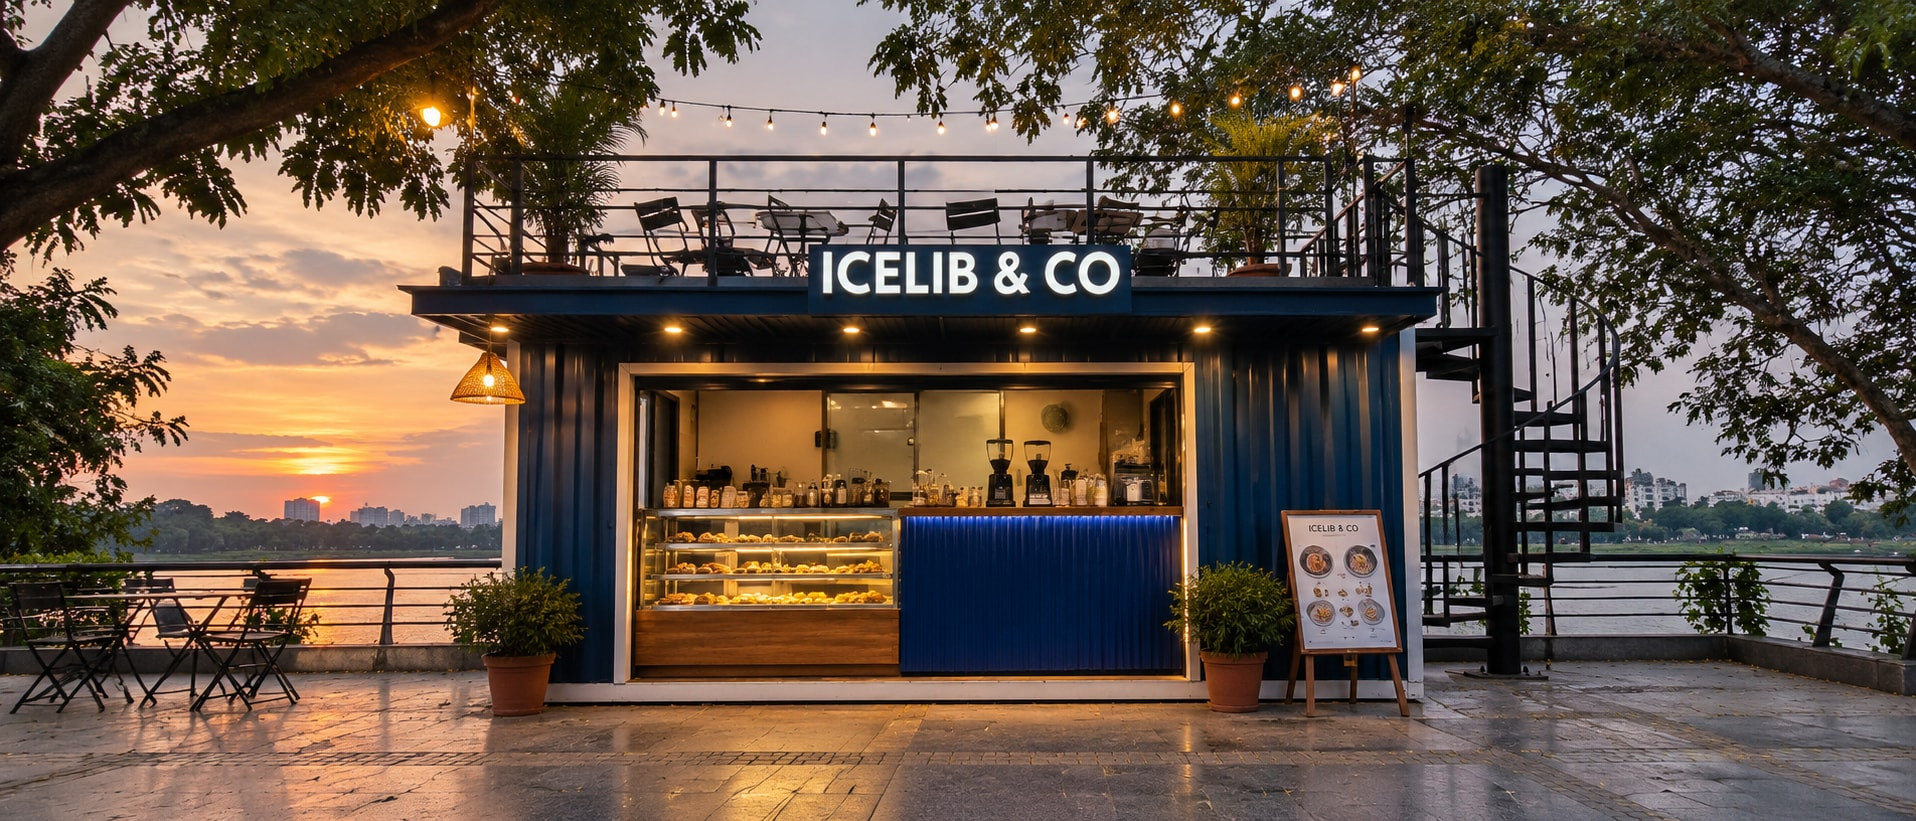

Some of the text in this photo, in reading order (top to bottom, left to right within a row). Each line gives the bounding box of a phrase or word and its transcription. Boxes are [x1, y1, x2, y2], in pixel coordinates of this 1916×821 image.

[822, 250, 1121, 295] ICELIB & CO
[1308, 524, 1336, 532] ICELIB
[1346, 524, 1359, 532] CO
